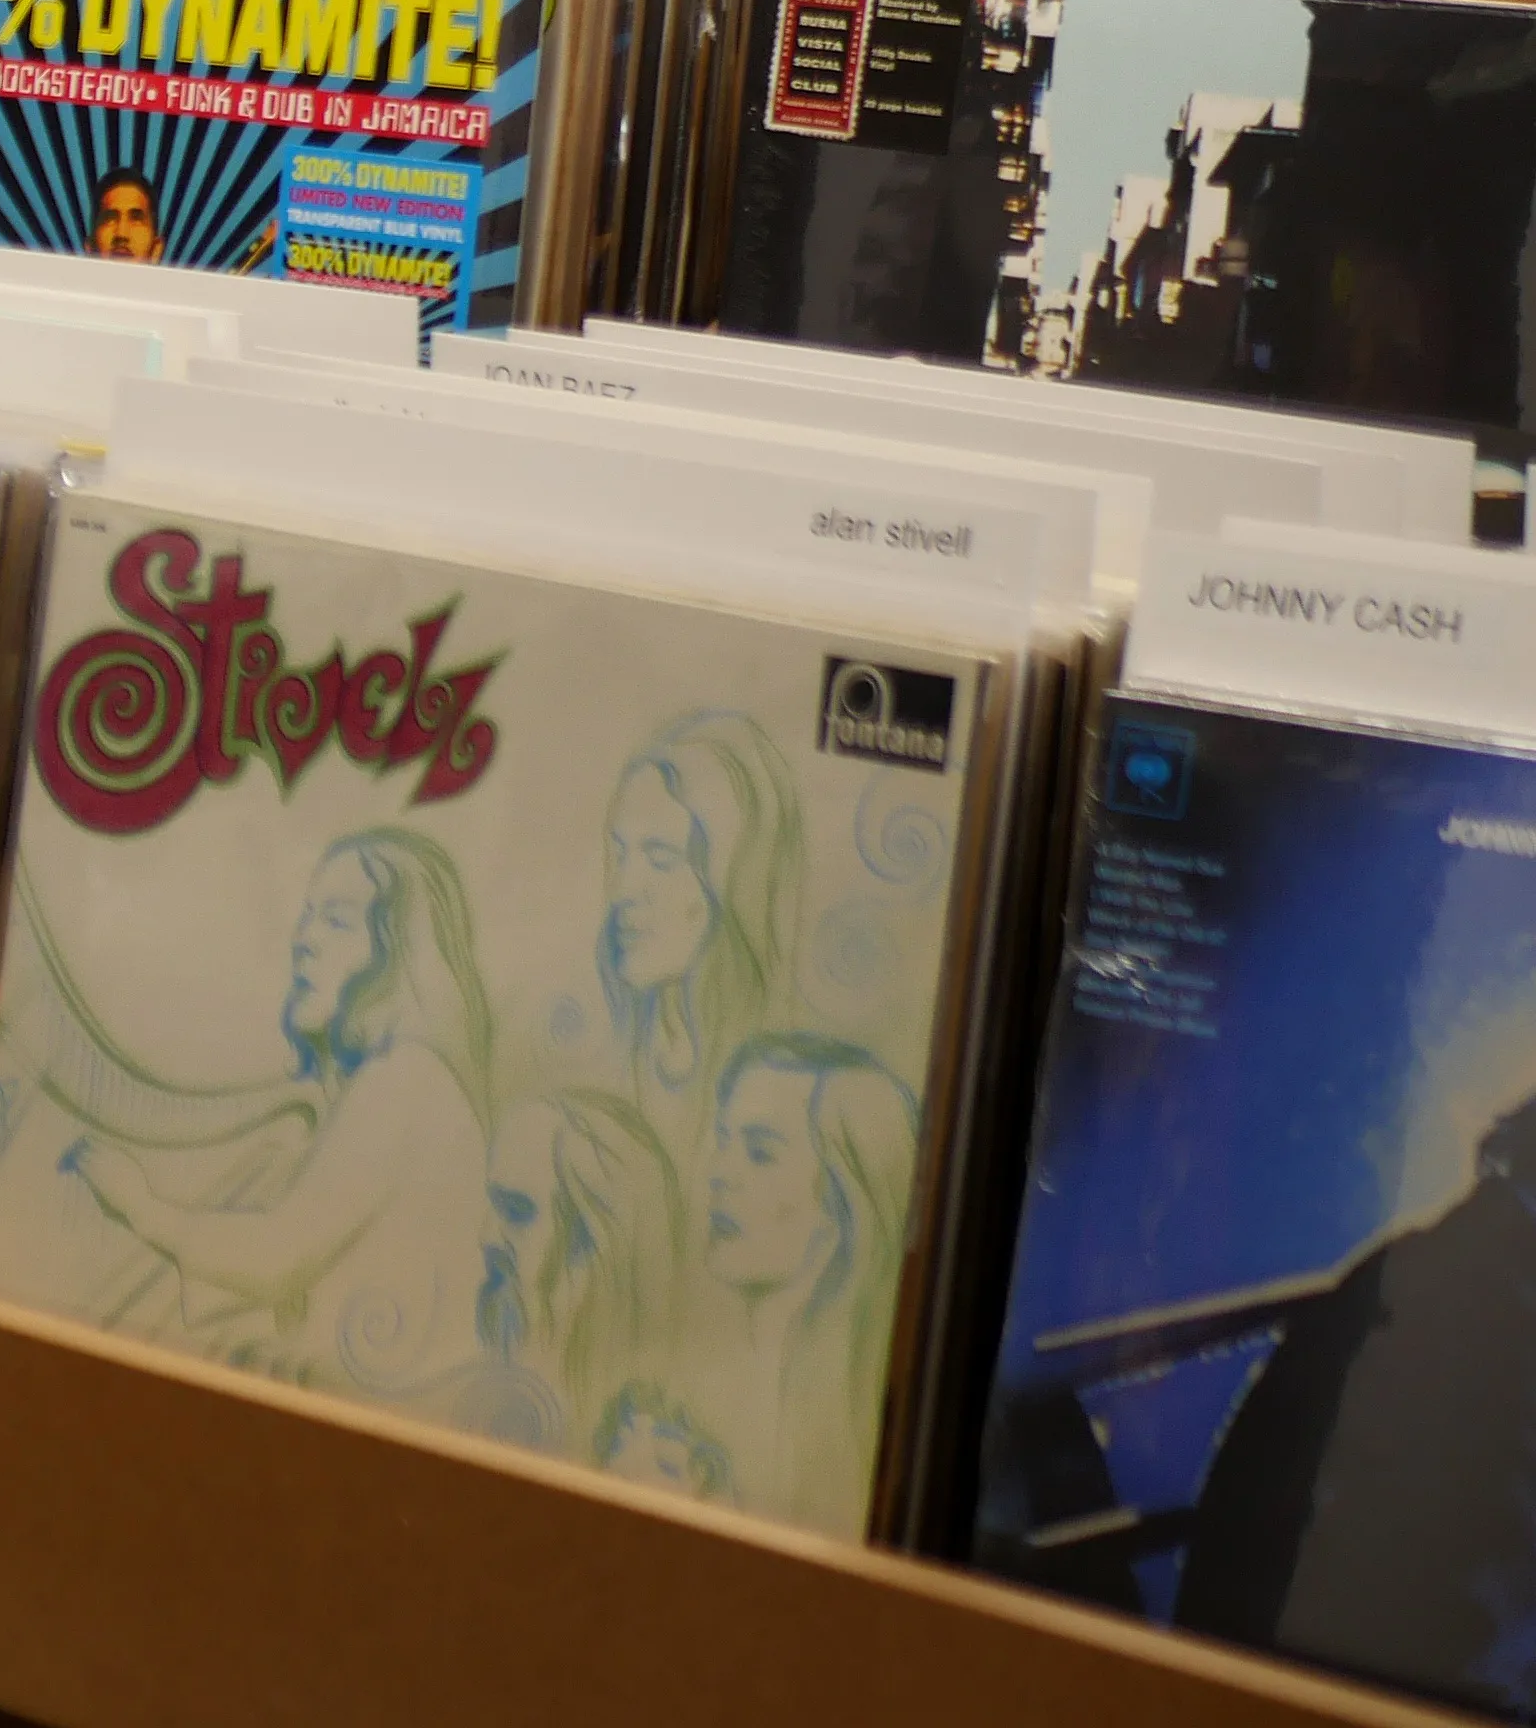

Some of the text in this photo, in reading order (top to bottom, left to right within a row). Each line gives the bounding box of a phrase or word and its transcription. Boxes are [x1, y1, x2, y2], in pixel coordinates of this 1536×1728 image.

[798, 13, 849, 31] BUENA
[797, 35, 844, 52] VISTA
[792, 55, 843, 72] SOCIAL
[790, 77, 839, 95] CLUB
[166, 78, 233, 116] FUNK
[239, 88, 256, 120] &
[262, 89, 315, 124] DUB
[324, 96, 353, 128] IN
[361, 101, 488, 142] JAMAICA
[291, 154, 469, 201] 300% DYNAMITE!
[289, 186, 465, 222] LIMITED NEW EDITION
[286, 207, 465, 245] TRANSPARENT BLUE VINYL
[288, 242, 345, 273] 300%
[809, 506, 974, 560] alan stivell
[1187, 572, 1465, 647] JOHNNY CASH
